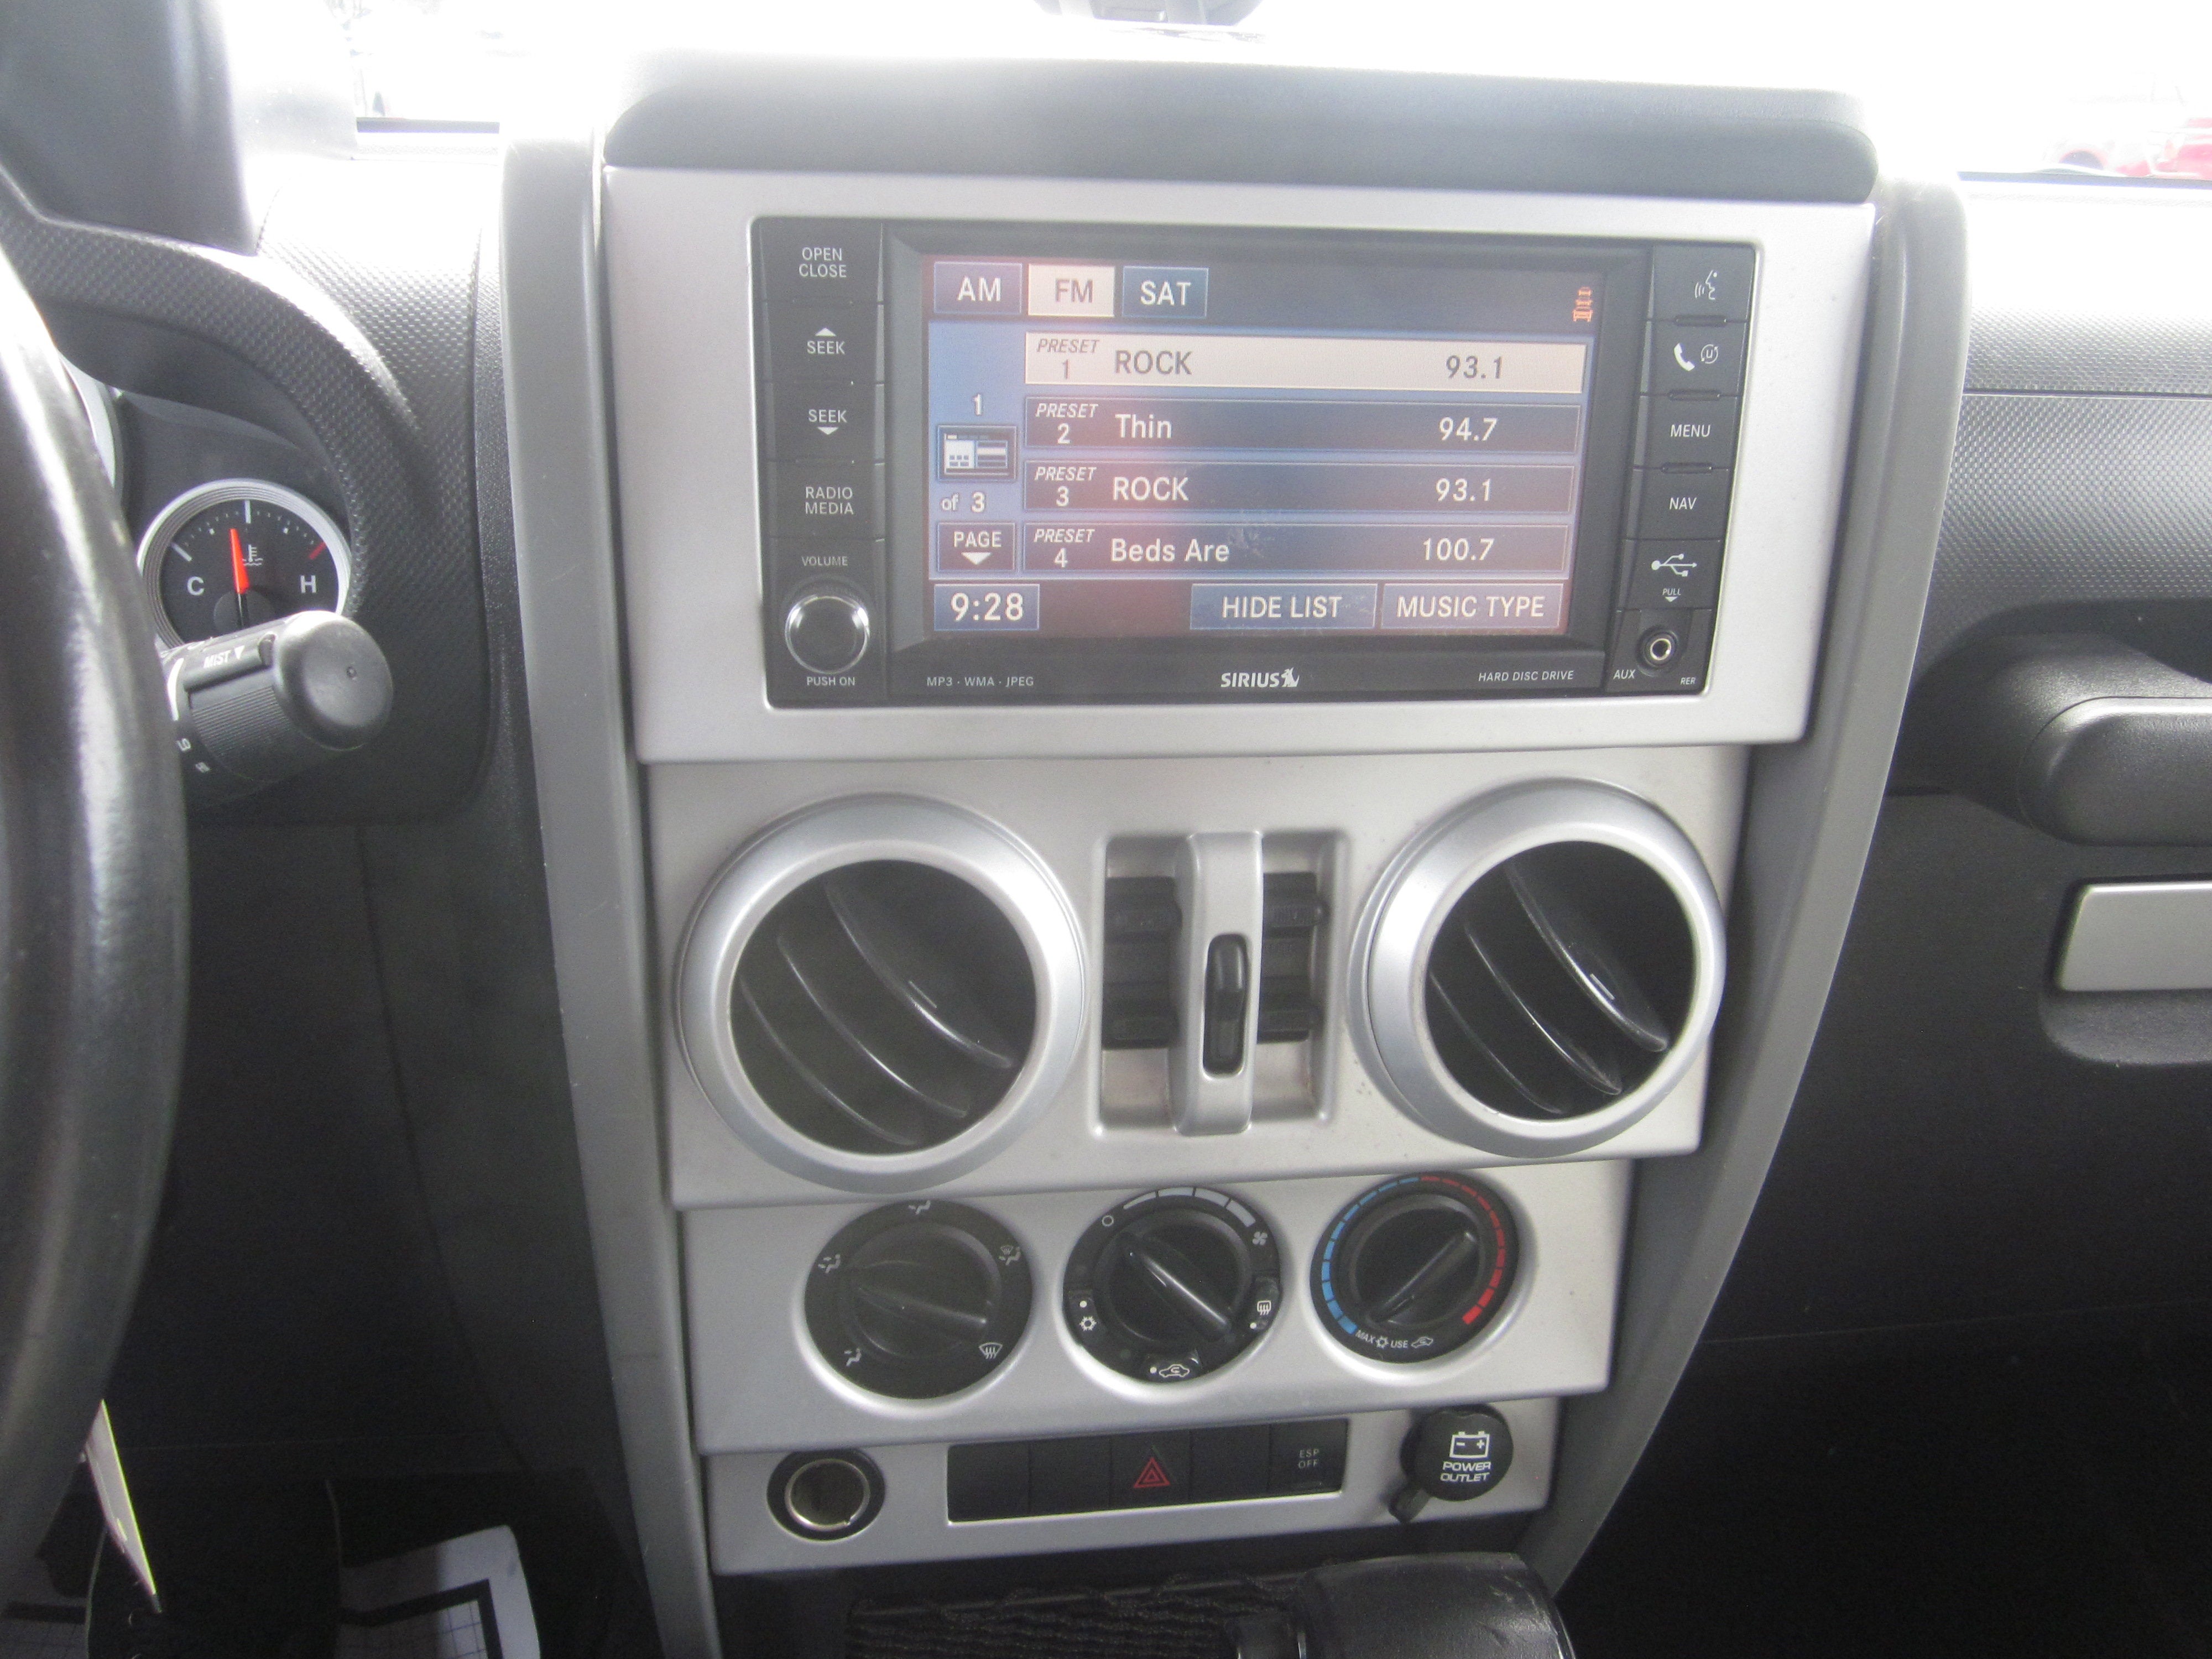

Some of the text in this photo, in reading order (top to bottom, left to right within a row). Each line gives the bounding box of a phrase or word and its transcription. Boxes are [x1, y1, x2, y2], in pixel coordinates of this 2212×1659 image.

[801, 247, 842, 261] OPEN
[799, 264, 847, 278] CLOSE
[957, 276, 1001, 301] AM
[1055, 279, 1093, 304] FM
[1140, 280, 1192, 306] SAT
[807, 341, 844, 354] SEEK
[1037, 338, 1100, 353] PRESET
[1061, 359, 1070, 380] 1
[1114, 351, 1192, 375] ROCK
[1445, 354, 1503, 379] 93.1
[972, 393, 983, 416] 1
[1035, 403, 1098, 418] PRESET
[808, 409, 847, 422] SEEK
[1057, 423, 1071, 444] 2
[1115, 414, 1172, 439] Thin
[1439, 417, 1498, 441] 94.7
[1671, 425, 1710, 437] MENU
[1034, 466, 1097, 481] PRESET
[805, 487, 853, 499] RADIO
[1112, 476, 1188, 500] ROCK
[1436, 478, 1492, 501] 93.1
[941, 492, 987, 513] of 3
[1056, 487, 1070, 507] 3
[1670, 497, 1697, 510] NAV
[805, 502, 854, 515] MEDIA
[953, 531, 1003, 548] PAGE
[1033, 528, 1095, 543] PRESET
[1054, 548, 1068, 568] 4
[1110, 538, 1230, 562] Beds Are
[1422, 538, 1494, 561] 100.7
[802, 556, 848, 566] VOLUME
[187, 576, 205, 596] C
[300, 575, 317, 593] H
[951, 592, 1024, 622] 9:28
[1222, 596, 1342, 618] HIDE LIST
[1397, 596, 1546, 617] MUSIC TYPE
[806, 676, 855, 686] PUSH ON
[927, 676, 1034, 687] MP3 WMA JPEG
[1220, 672, 1280, 688] SIRIUS
[1478, 670, 1574, 682] HARD DISC DRIVE
[1613, 669, 1636, 680] AUX
[1355, 1329, 1408, 1348] MAX USE
[1299, 1449, 1319, 1458] ESP
[1298, 1459, 1319, 1469] OFF
[1442, 1461, 1491, 1472] POWER
[1440, 1472, 1490, 1483] OUTLET
